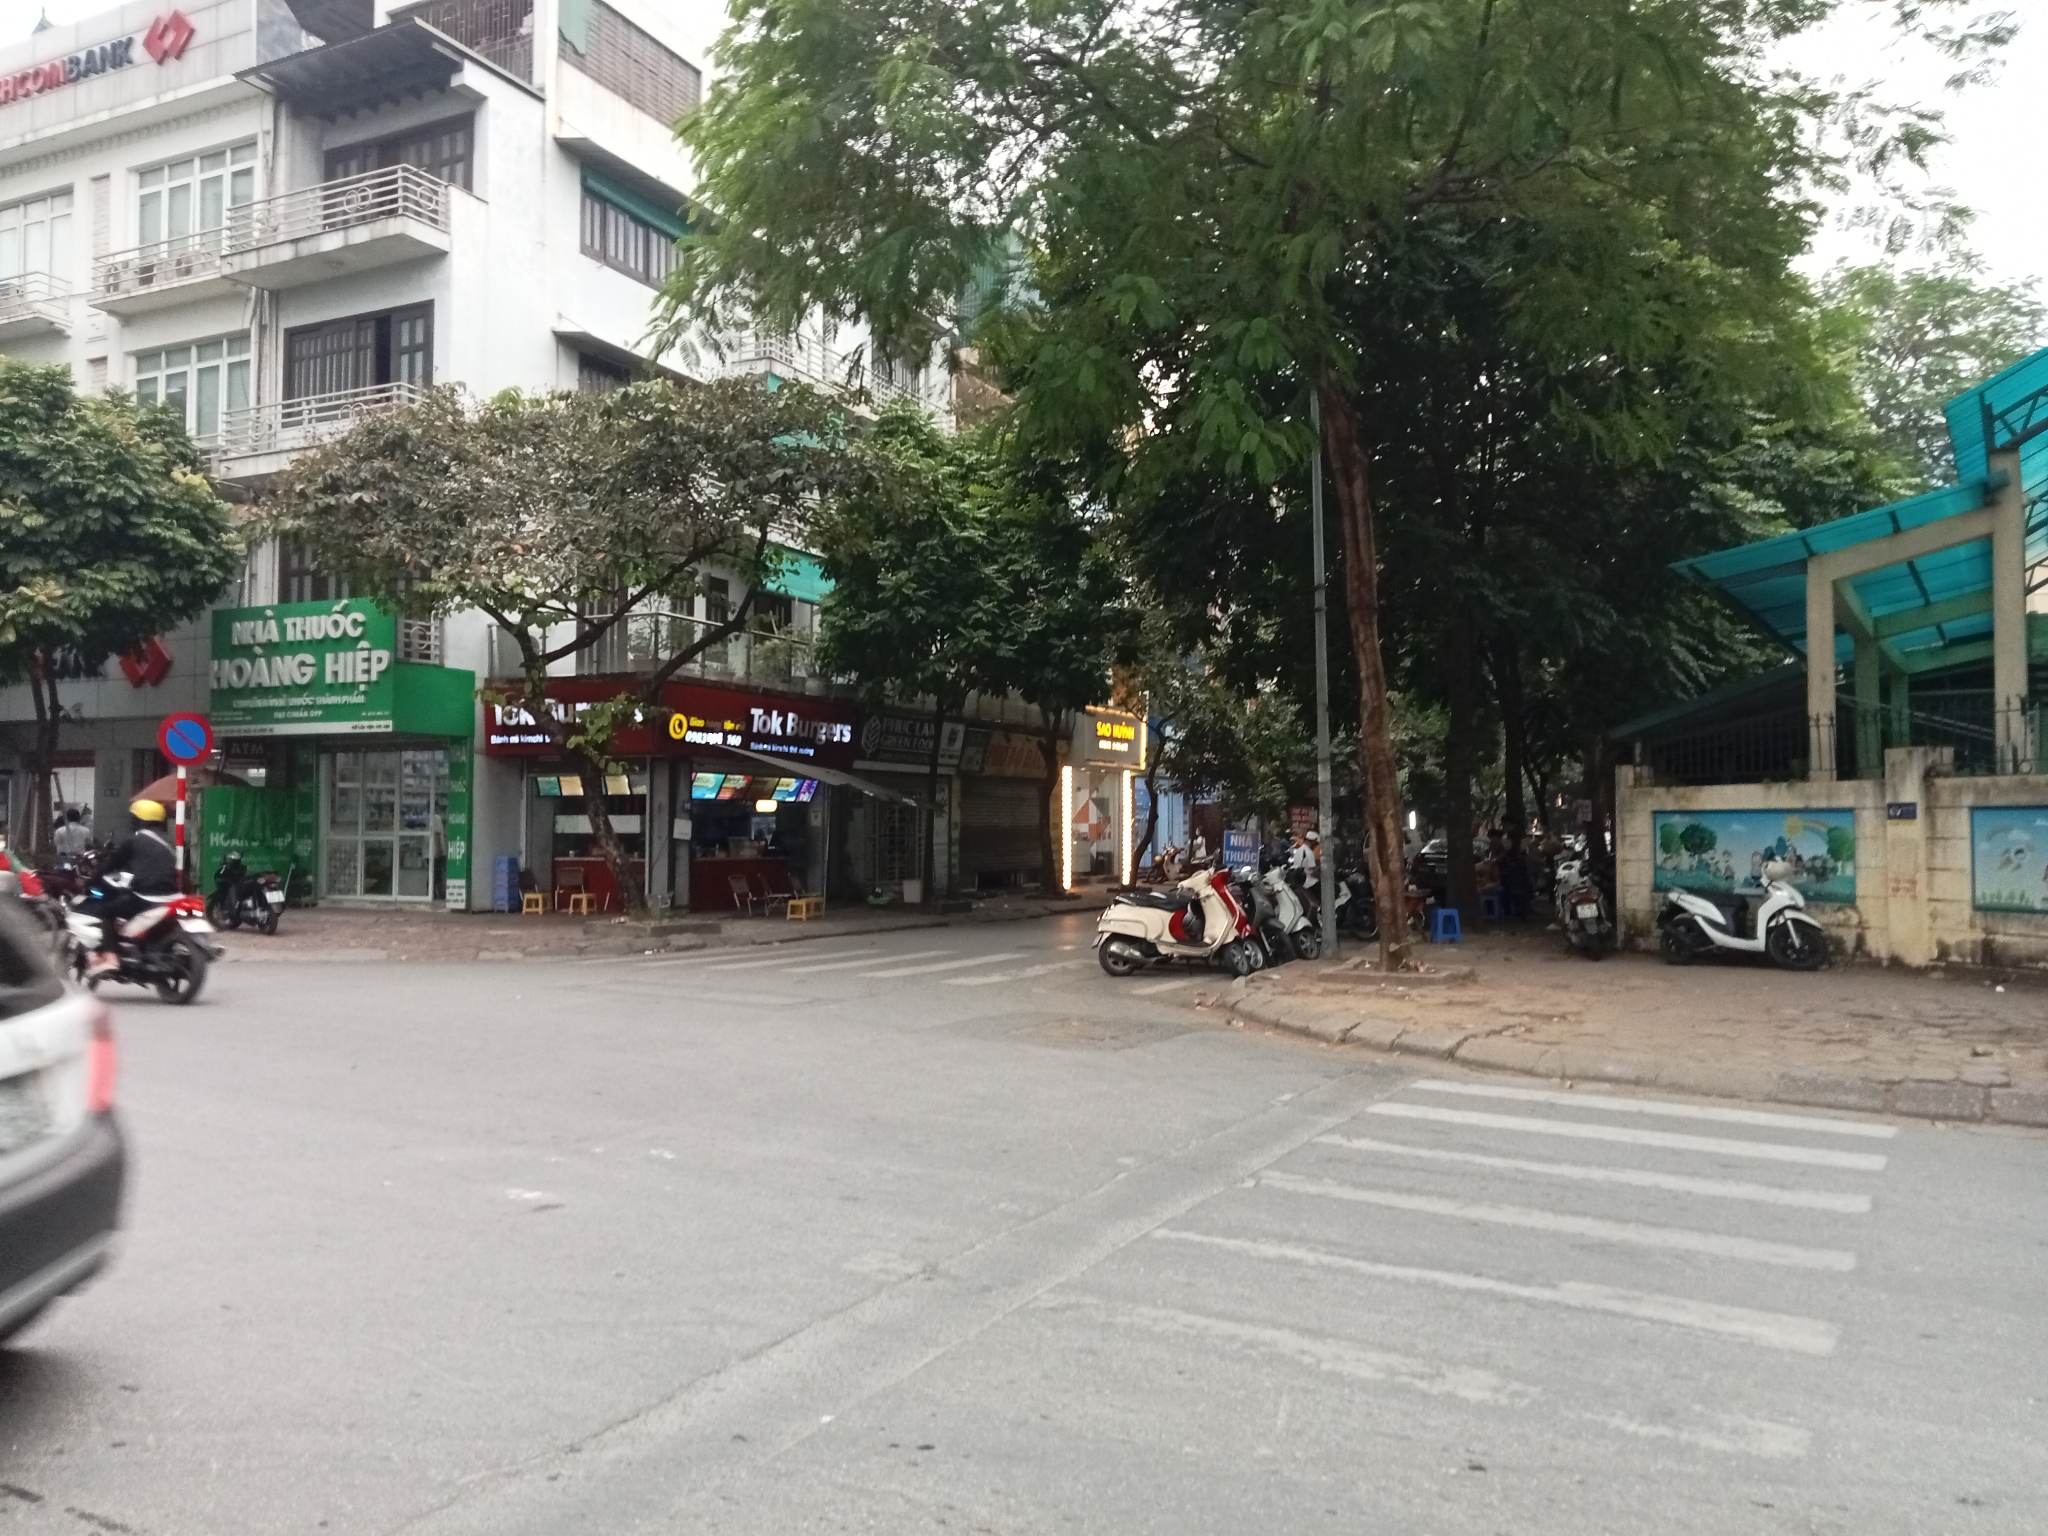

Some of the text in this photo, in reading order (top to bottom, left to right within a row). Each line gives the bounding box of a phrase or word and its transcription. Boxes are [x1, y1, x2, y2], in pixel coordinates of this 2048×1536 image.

[231, 600, 366, 645] NHÀ THUỐC
[210, 640, 390, 691] HOÀNG HIỆP
[750, 708, 852, 744] Tok Burgers
[1096, 721, 1112, 738] SAO
